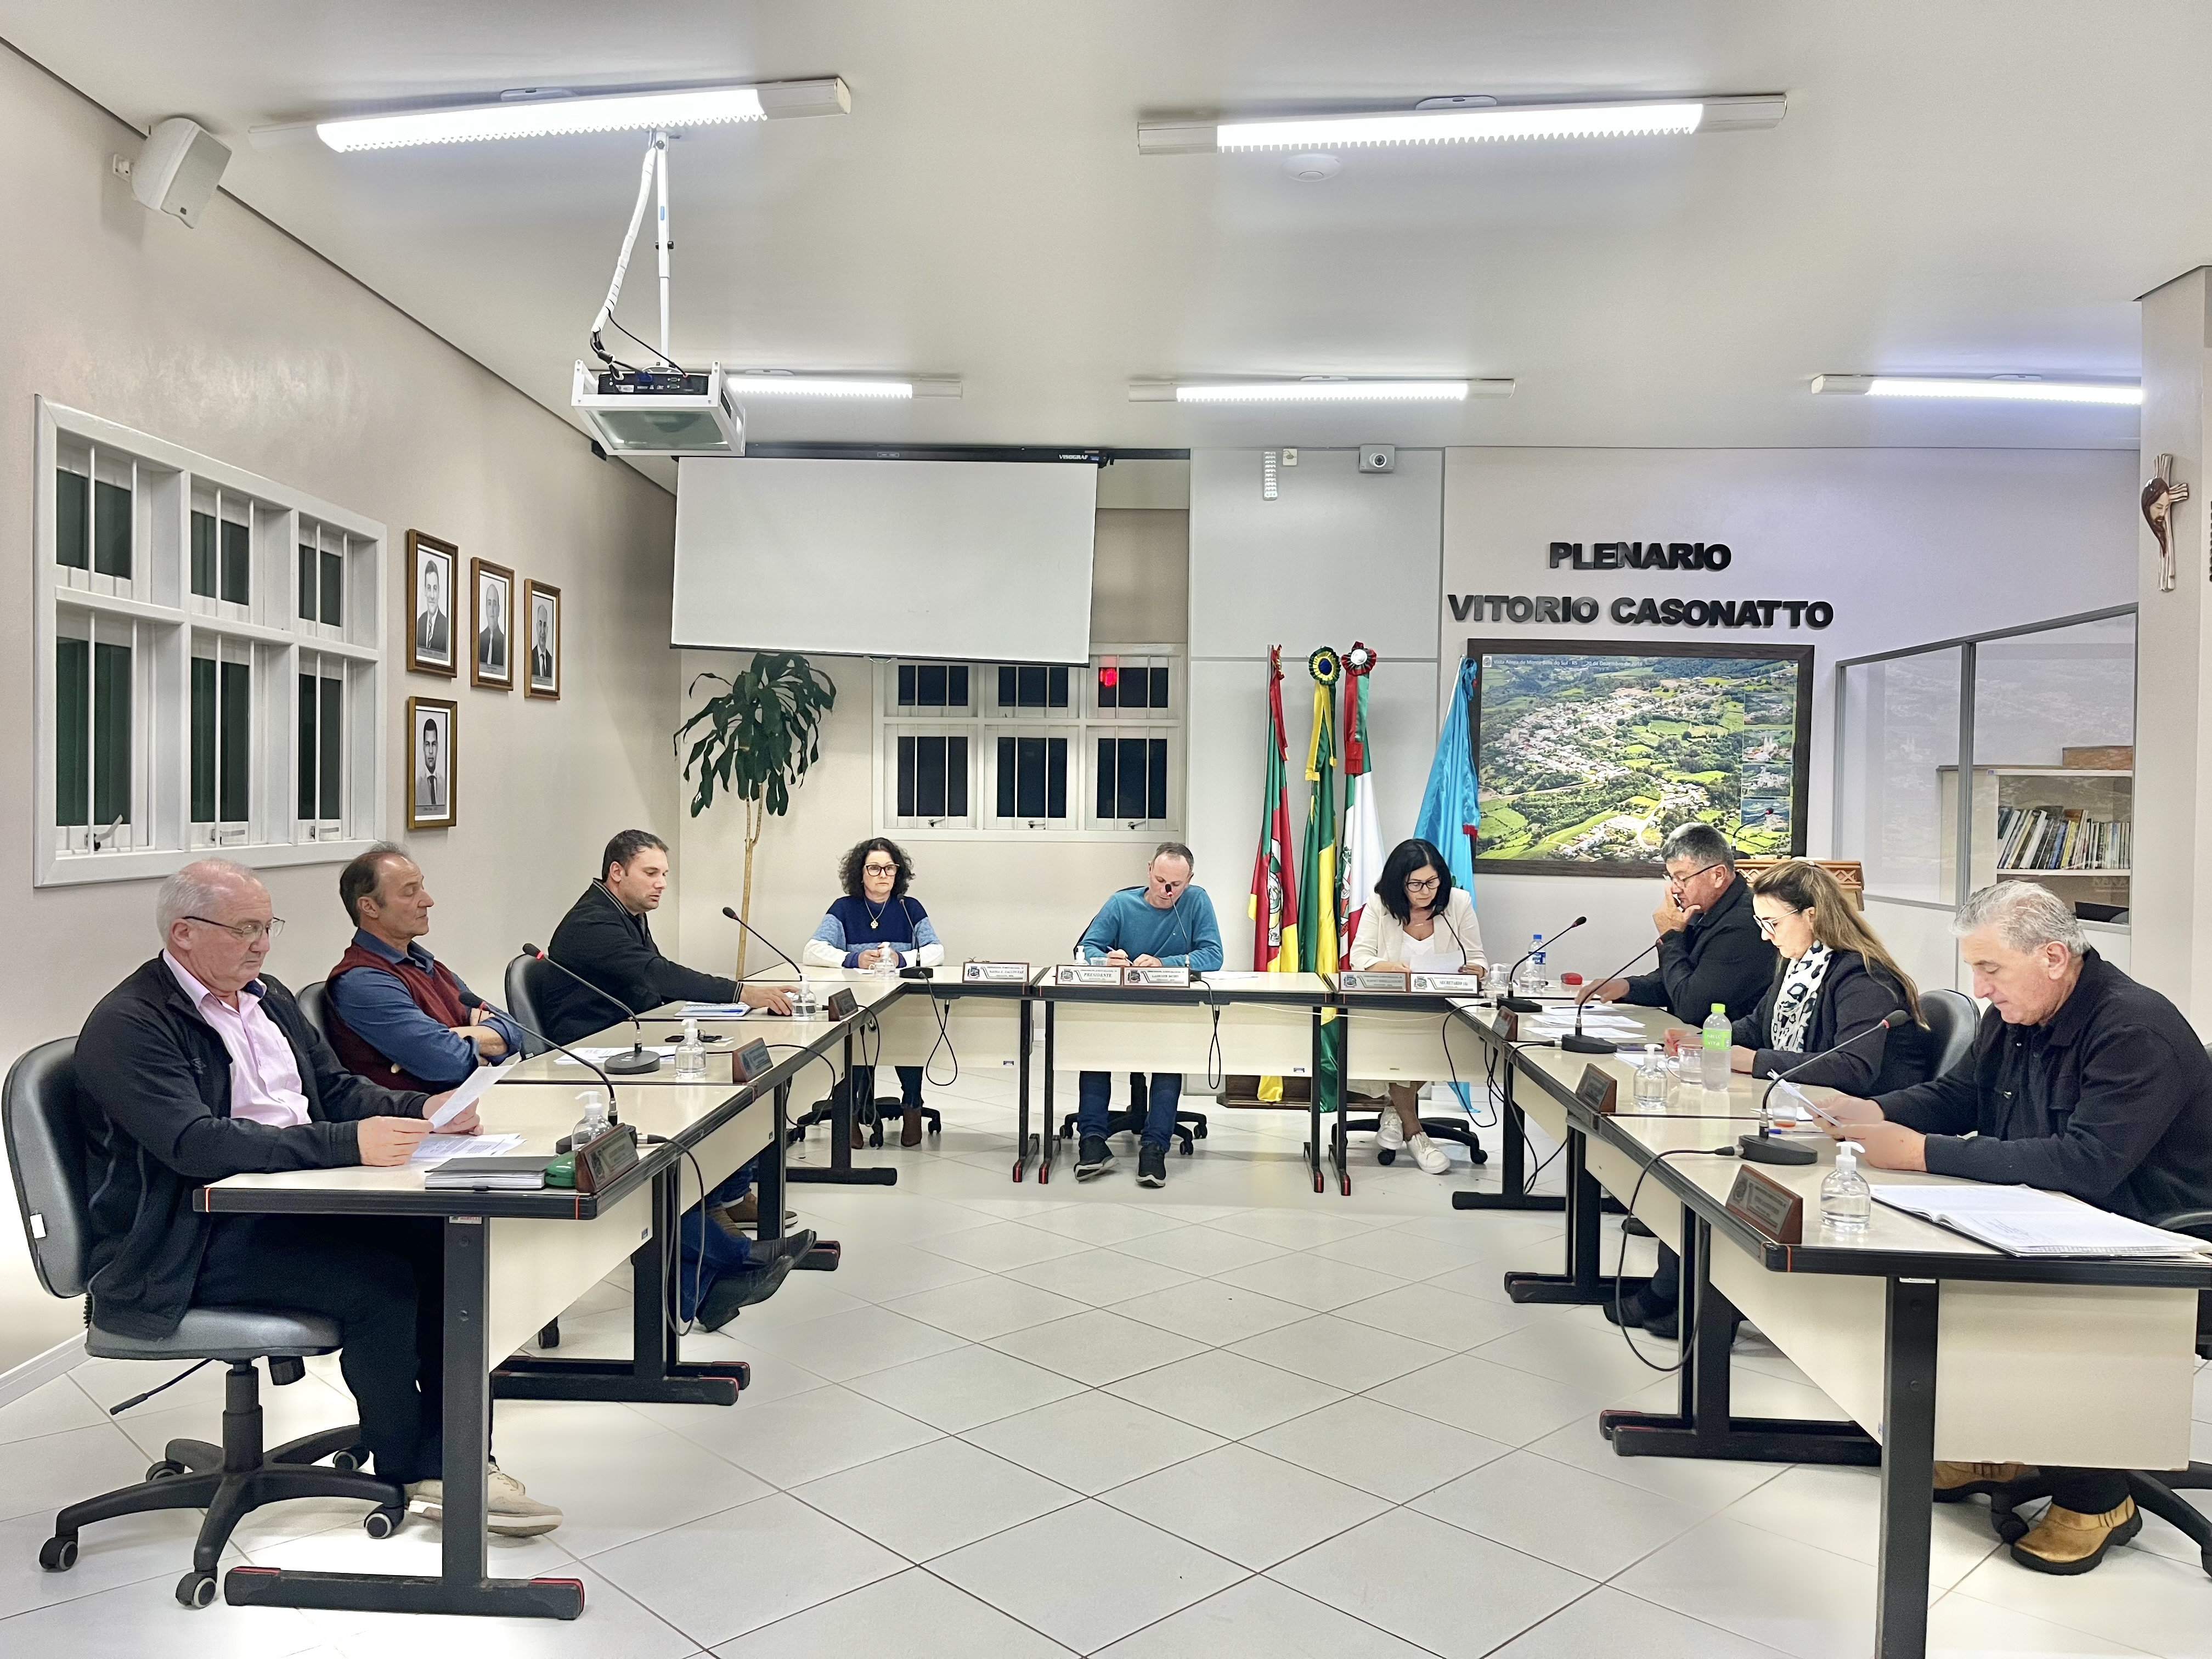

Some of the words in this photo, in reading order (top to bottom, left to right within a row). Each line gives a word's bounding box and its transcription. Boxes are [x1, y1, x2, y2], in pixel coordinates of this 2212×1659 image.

[1549, 541, 1732, 570] PLENARIO
[1447, 594, 1599, 624] VITORIO
[1610, 597, 1834, 628] CASONATTO
